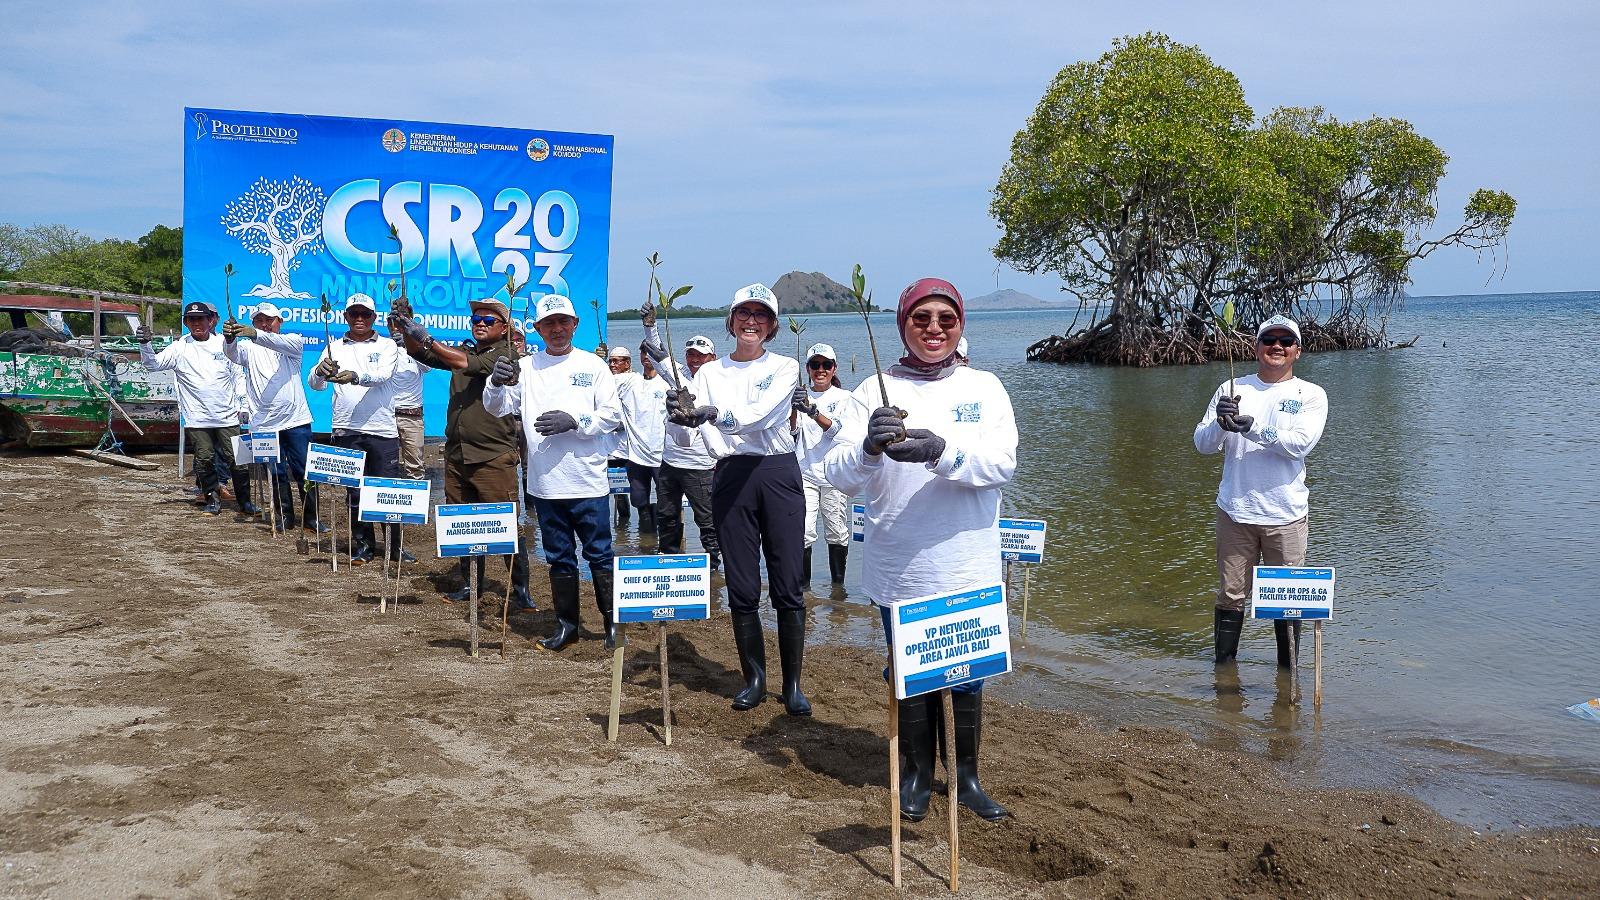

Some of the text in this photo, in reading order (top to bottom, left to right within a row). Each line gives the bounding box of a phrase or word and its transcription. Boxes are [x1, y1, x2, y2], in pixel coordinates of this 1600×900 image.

[211, 119, 298, 138] PROTELINDO
[410, 132, 456, 142] KEMENTERIAN
[409, 145, 478, 155] REPUBLIK INDONESIA
[410, 138, 453, 147] LINGKUNGAN
[453, 141, 473, 149] HIDUP
[479, 143, 519, 152] KEHUTANAN
[552, 144, 608, 154] TAMAN NASIONAL
[552, 150, 582, 159] KOMODO
[492, 187, 580, 252] 20
[321, 178, 487, 279] CSR
[490, 250, 574, 312] 23
[321, 273, 486, 309] MANGROVE
[377, 492, 398, 501] KEPALA
[451, 520, 502, 529] KADIS KOMINFO
[446, 526, 508, 536] MANGGARAI BARAT
[623, 576, 642, 584] CHIEF
[642, 575, 652, 583] OF
[652, 575, 671, 583] SALES
[675, 574, 702, 582] LEASING
[655, 583, 670, 591] AND
[1259, 586, 1276, 594] HEAD
[1286, 587, 1296, 595] HR
[1297, 587, 1310, 595] OPS
[620, 589, 705, 600] PARTNERSHIP PROTELINDO
[1288, 594, 1327, 602] PROTELINDO
[925, 617, 982, 640] VP NETWORK
[905, 624, 1002, 656] OPERATION TELKOMSEL
[919, 639, 990, 666] AREA JAWA BALI
